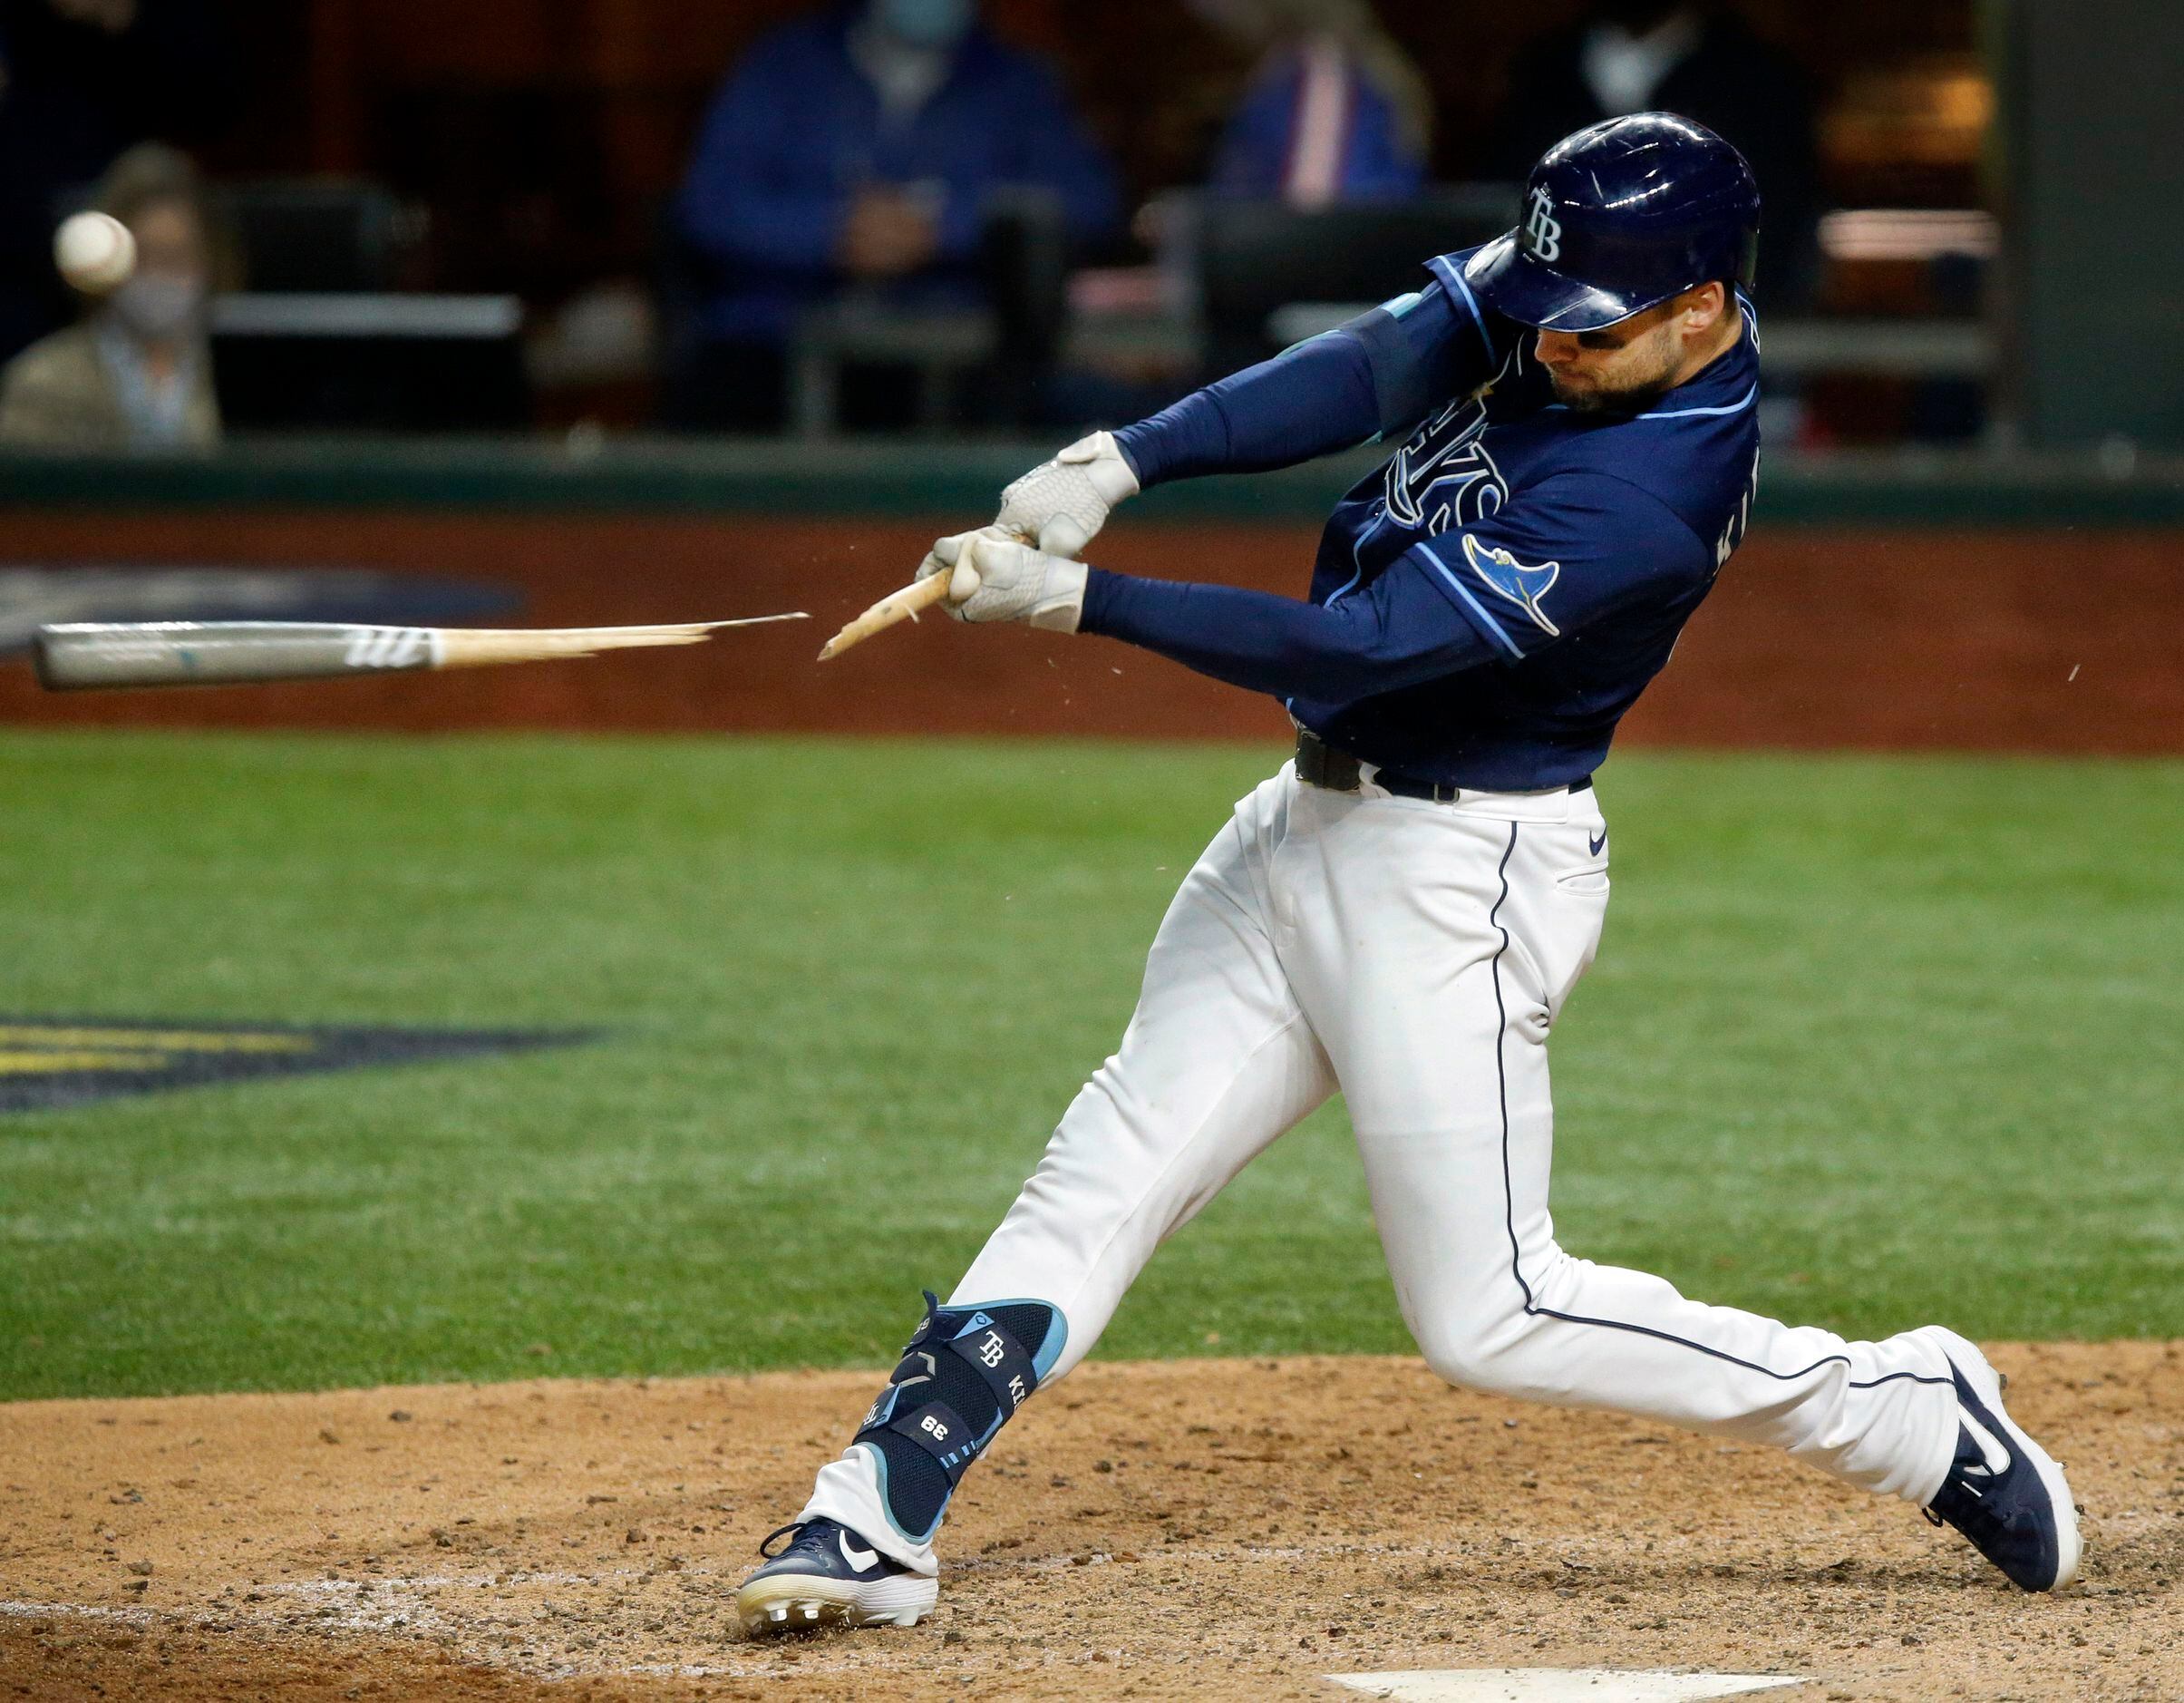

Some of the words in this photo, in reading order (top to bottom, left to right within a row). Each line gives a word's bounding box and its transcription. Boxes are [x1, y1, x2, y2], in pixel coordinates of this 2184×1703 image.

[1526, 187, 1561, 262] TB
[979, 1330, 1005, 1368] TB
[1008, 1374, 1026, 1406] KI
[920, 1415, 948, 1442] 39
